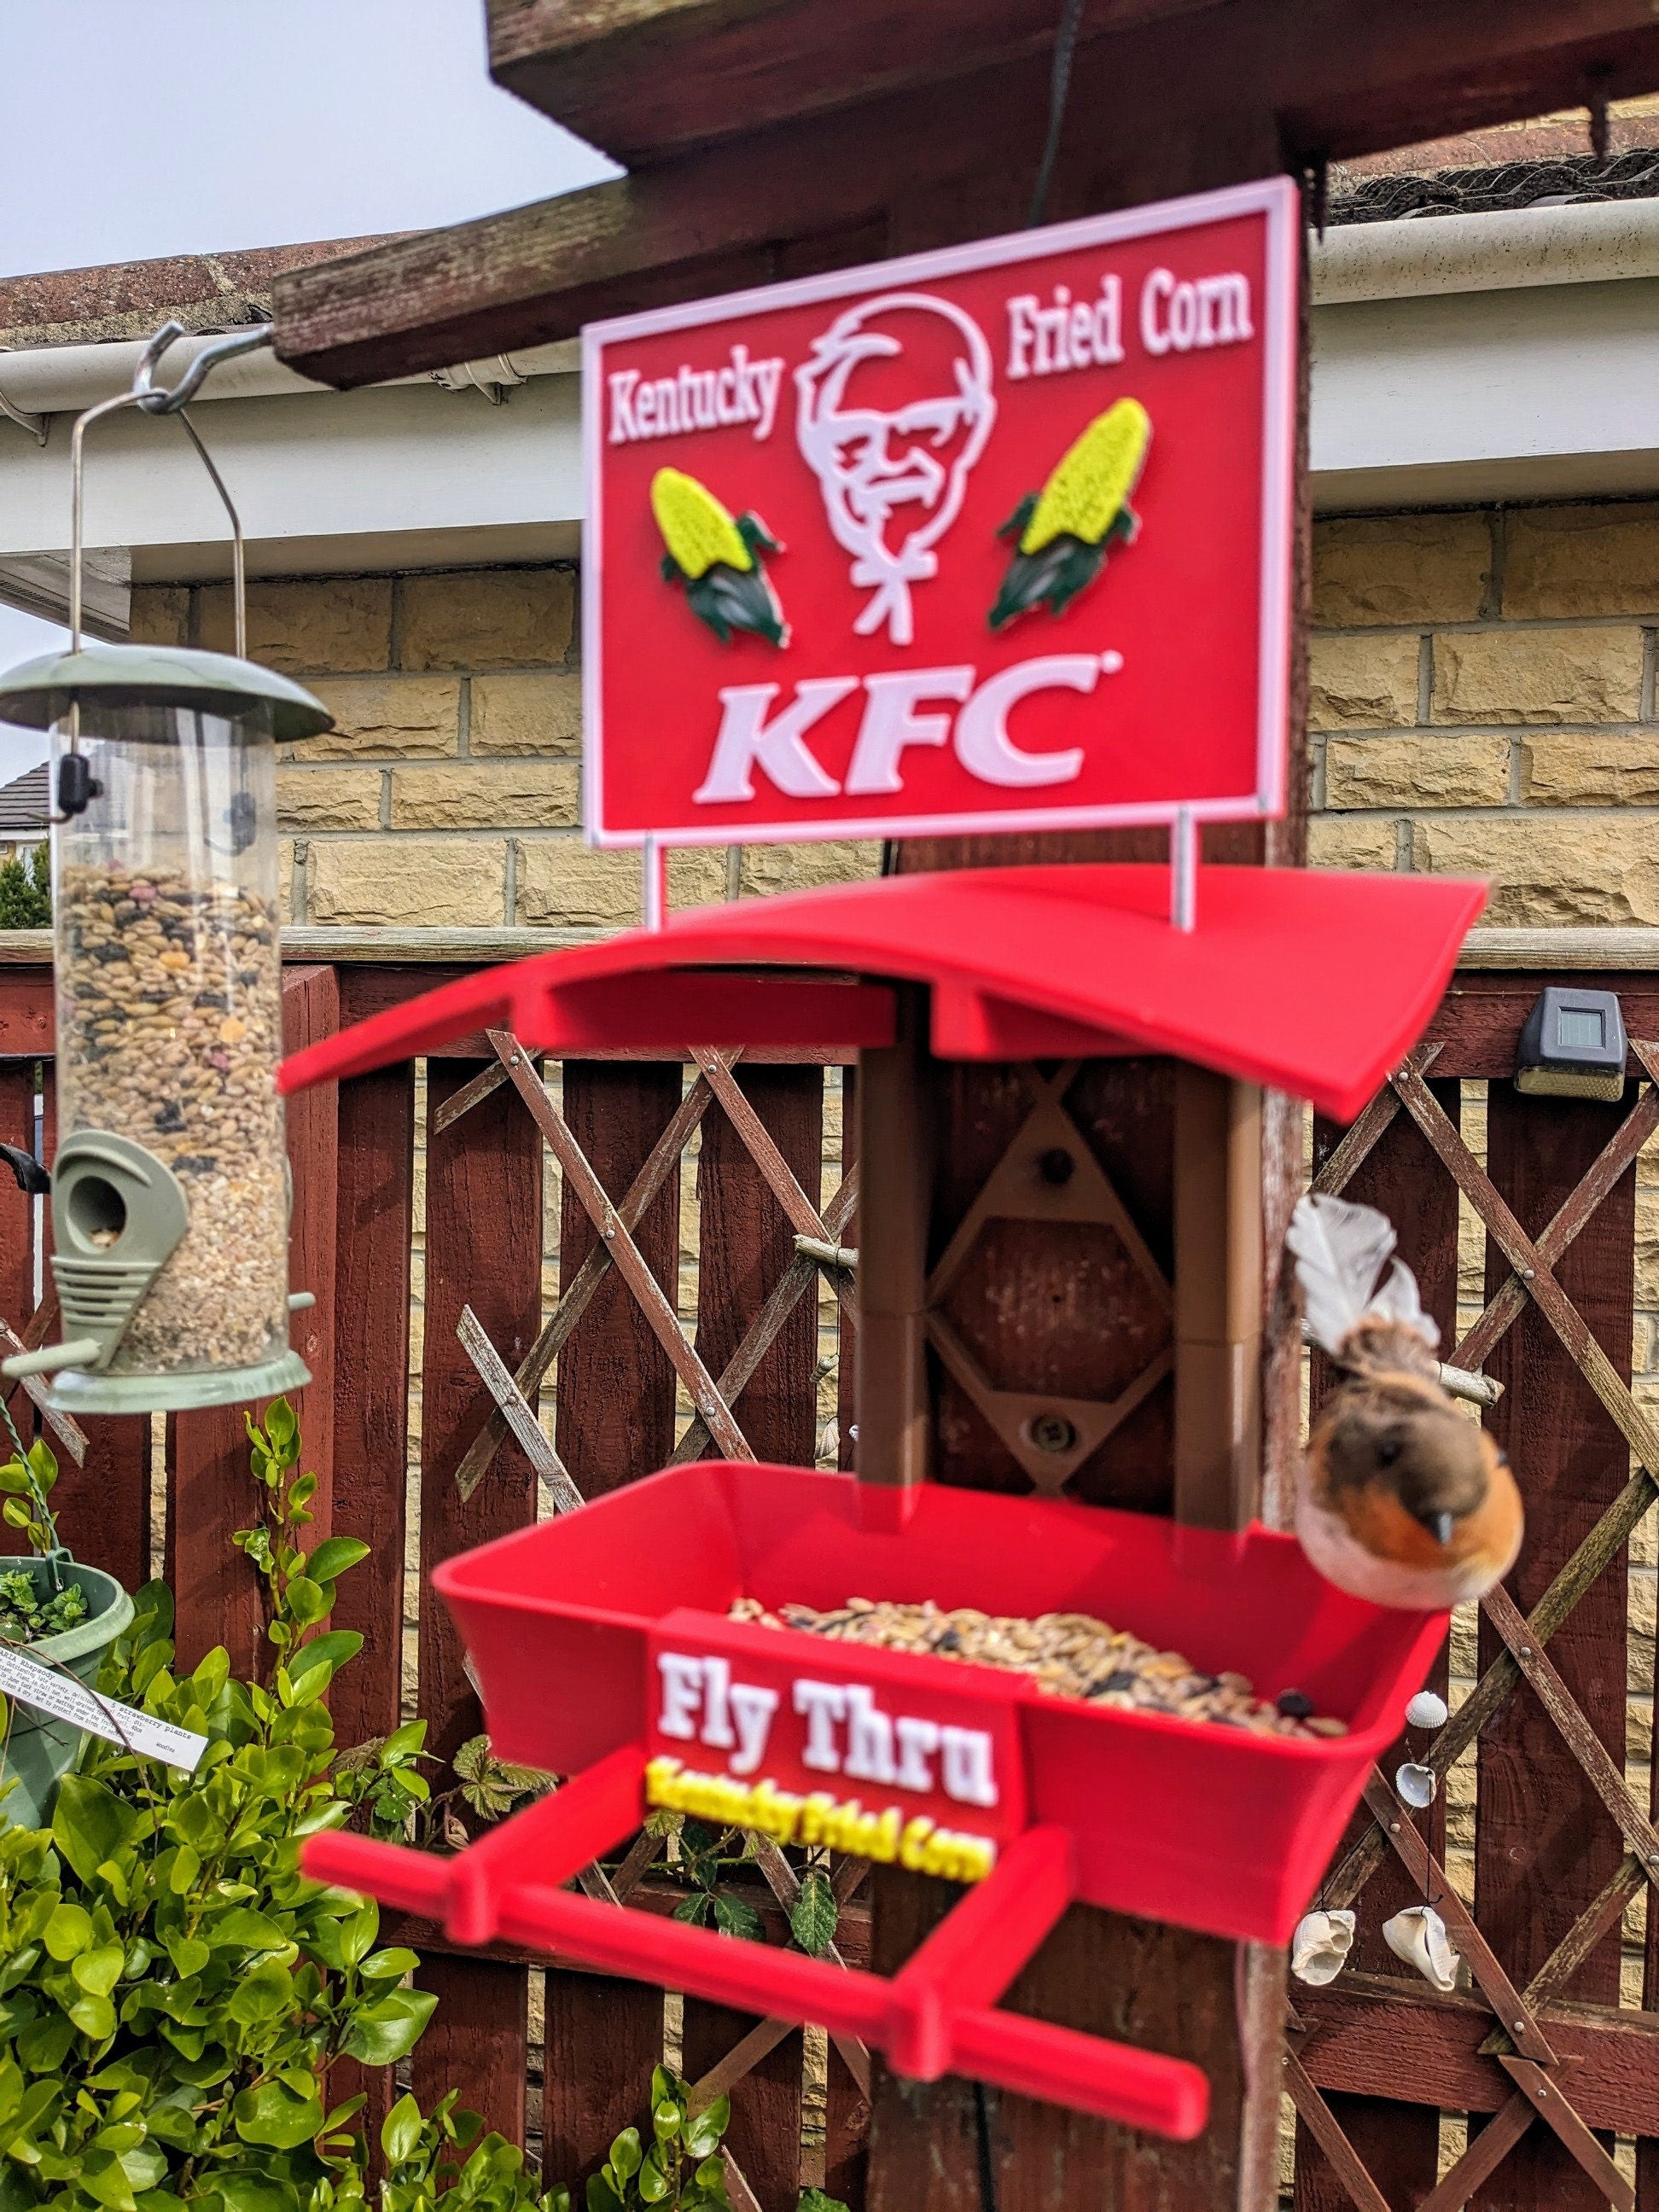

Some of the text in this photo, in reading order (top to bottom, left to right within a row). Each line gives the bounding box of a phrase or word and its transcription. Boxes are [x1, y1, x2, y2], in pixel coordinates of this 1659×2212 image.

[1004, 267, 1254, 381] Fried Corn
[608, 345, 785, 445] Kentucky
[692, 651, 1101, 805] KFC
[6, 1661, 36, 1679] Outstanding
[38, 1675, 49, 1684] late
[15, 1673, 30, 1683] Plant
[39, 1683, 50, 1691] full
[20, 1660, 55, 1680] Rhapsody
[2, 1680, 16, 1690] clean
[52, 1704, 72, 1715] protect
[73, 1713, 84, 1721] from
[84, 1718, 99, 1728] birds
[20, 1681, 32, 1691] tuck
[33, 1688, 48, 1697] straw
[55, 1698, 75, 1710] matting
[75, 1708, 90, 1716] under
[119, 1707, 162, 1729] strawberry
[164, 1726, 192, 1740] plants
[657, 1652, 998, 1807] Fly Thru
